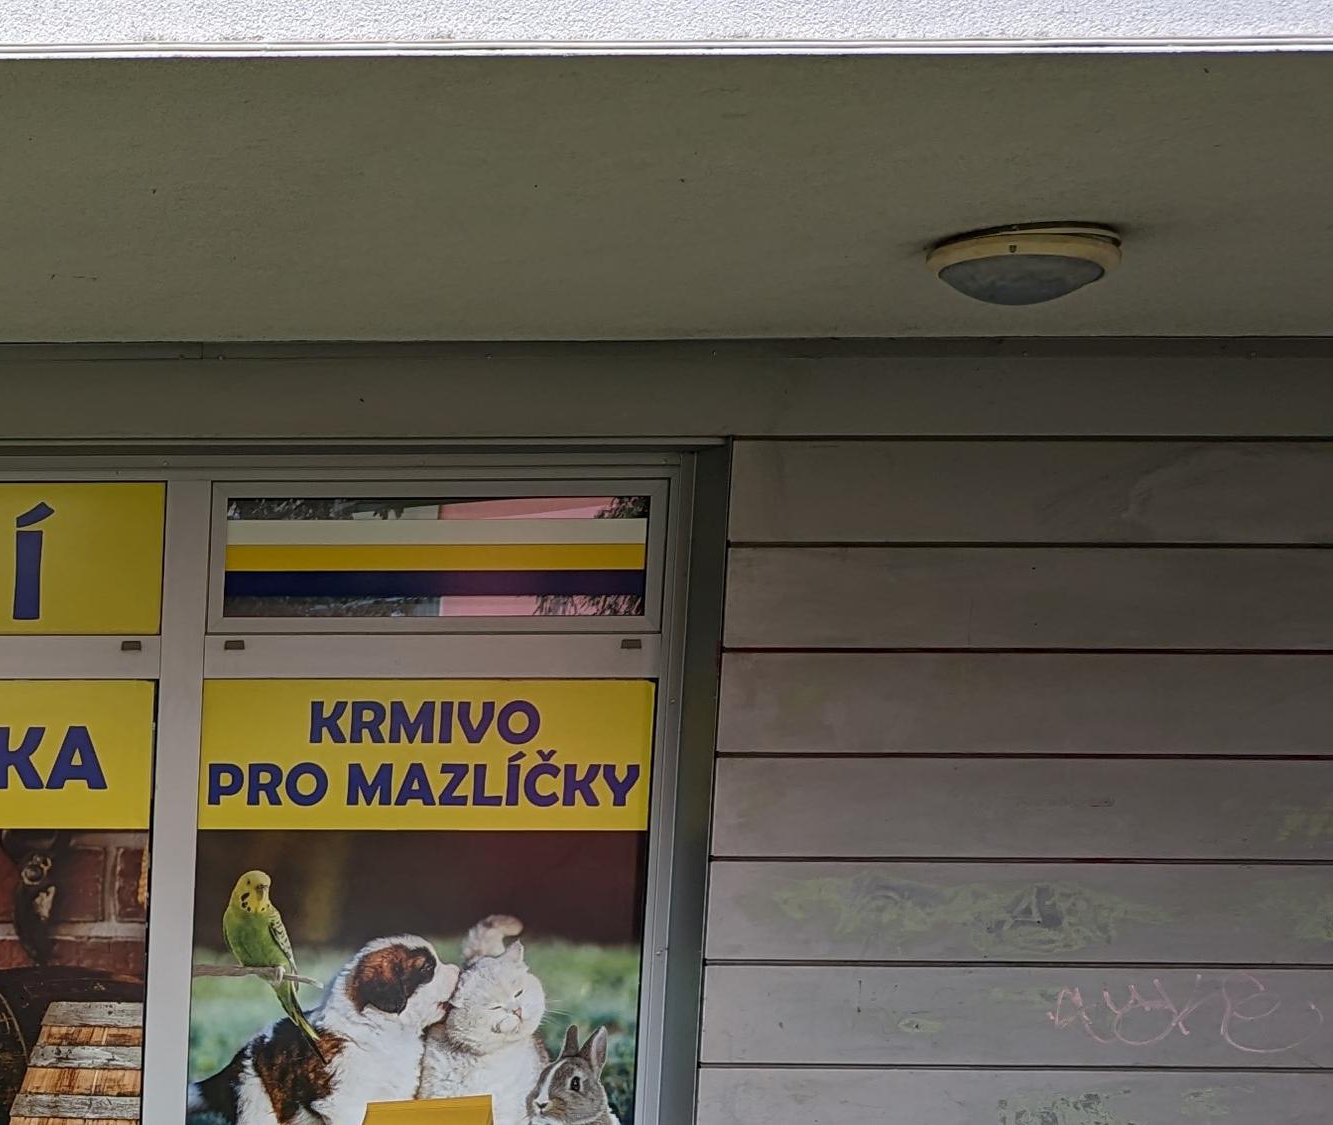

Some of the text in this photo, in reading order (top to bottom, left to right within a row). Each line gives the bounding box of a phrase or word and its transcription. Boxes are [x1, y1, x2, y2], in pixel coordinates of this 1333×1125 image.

[308, 699, 541, 744] KRMIVO
[206, 749, 640, 807] PRO MAZLÍČKY
